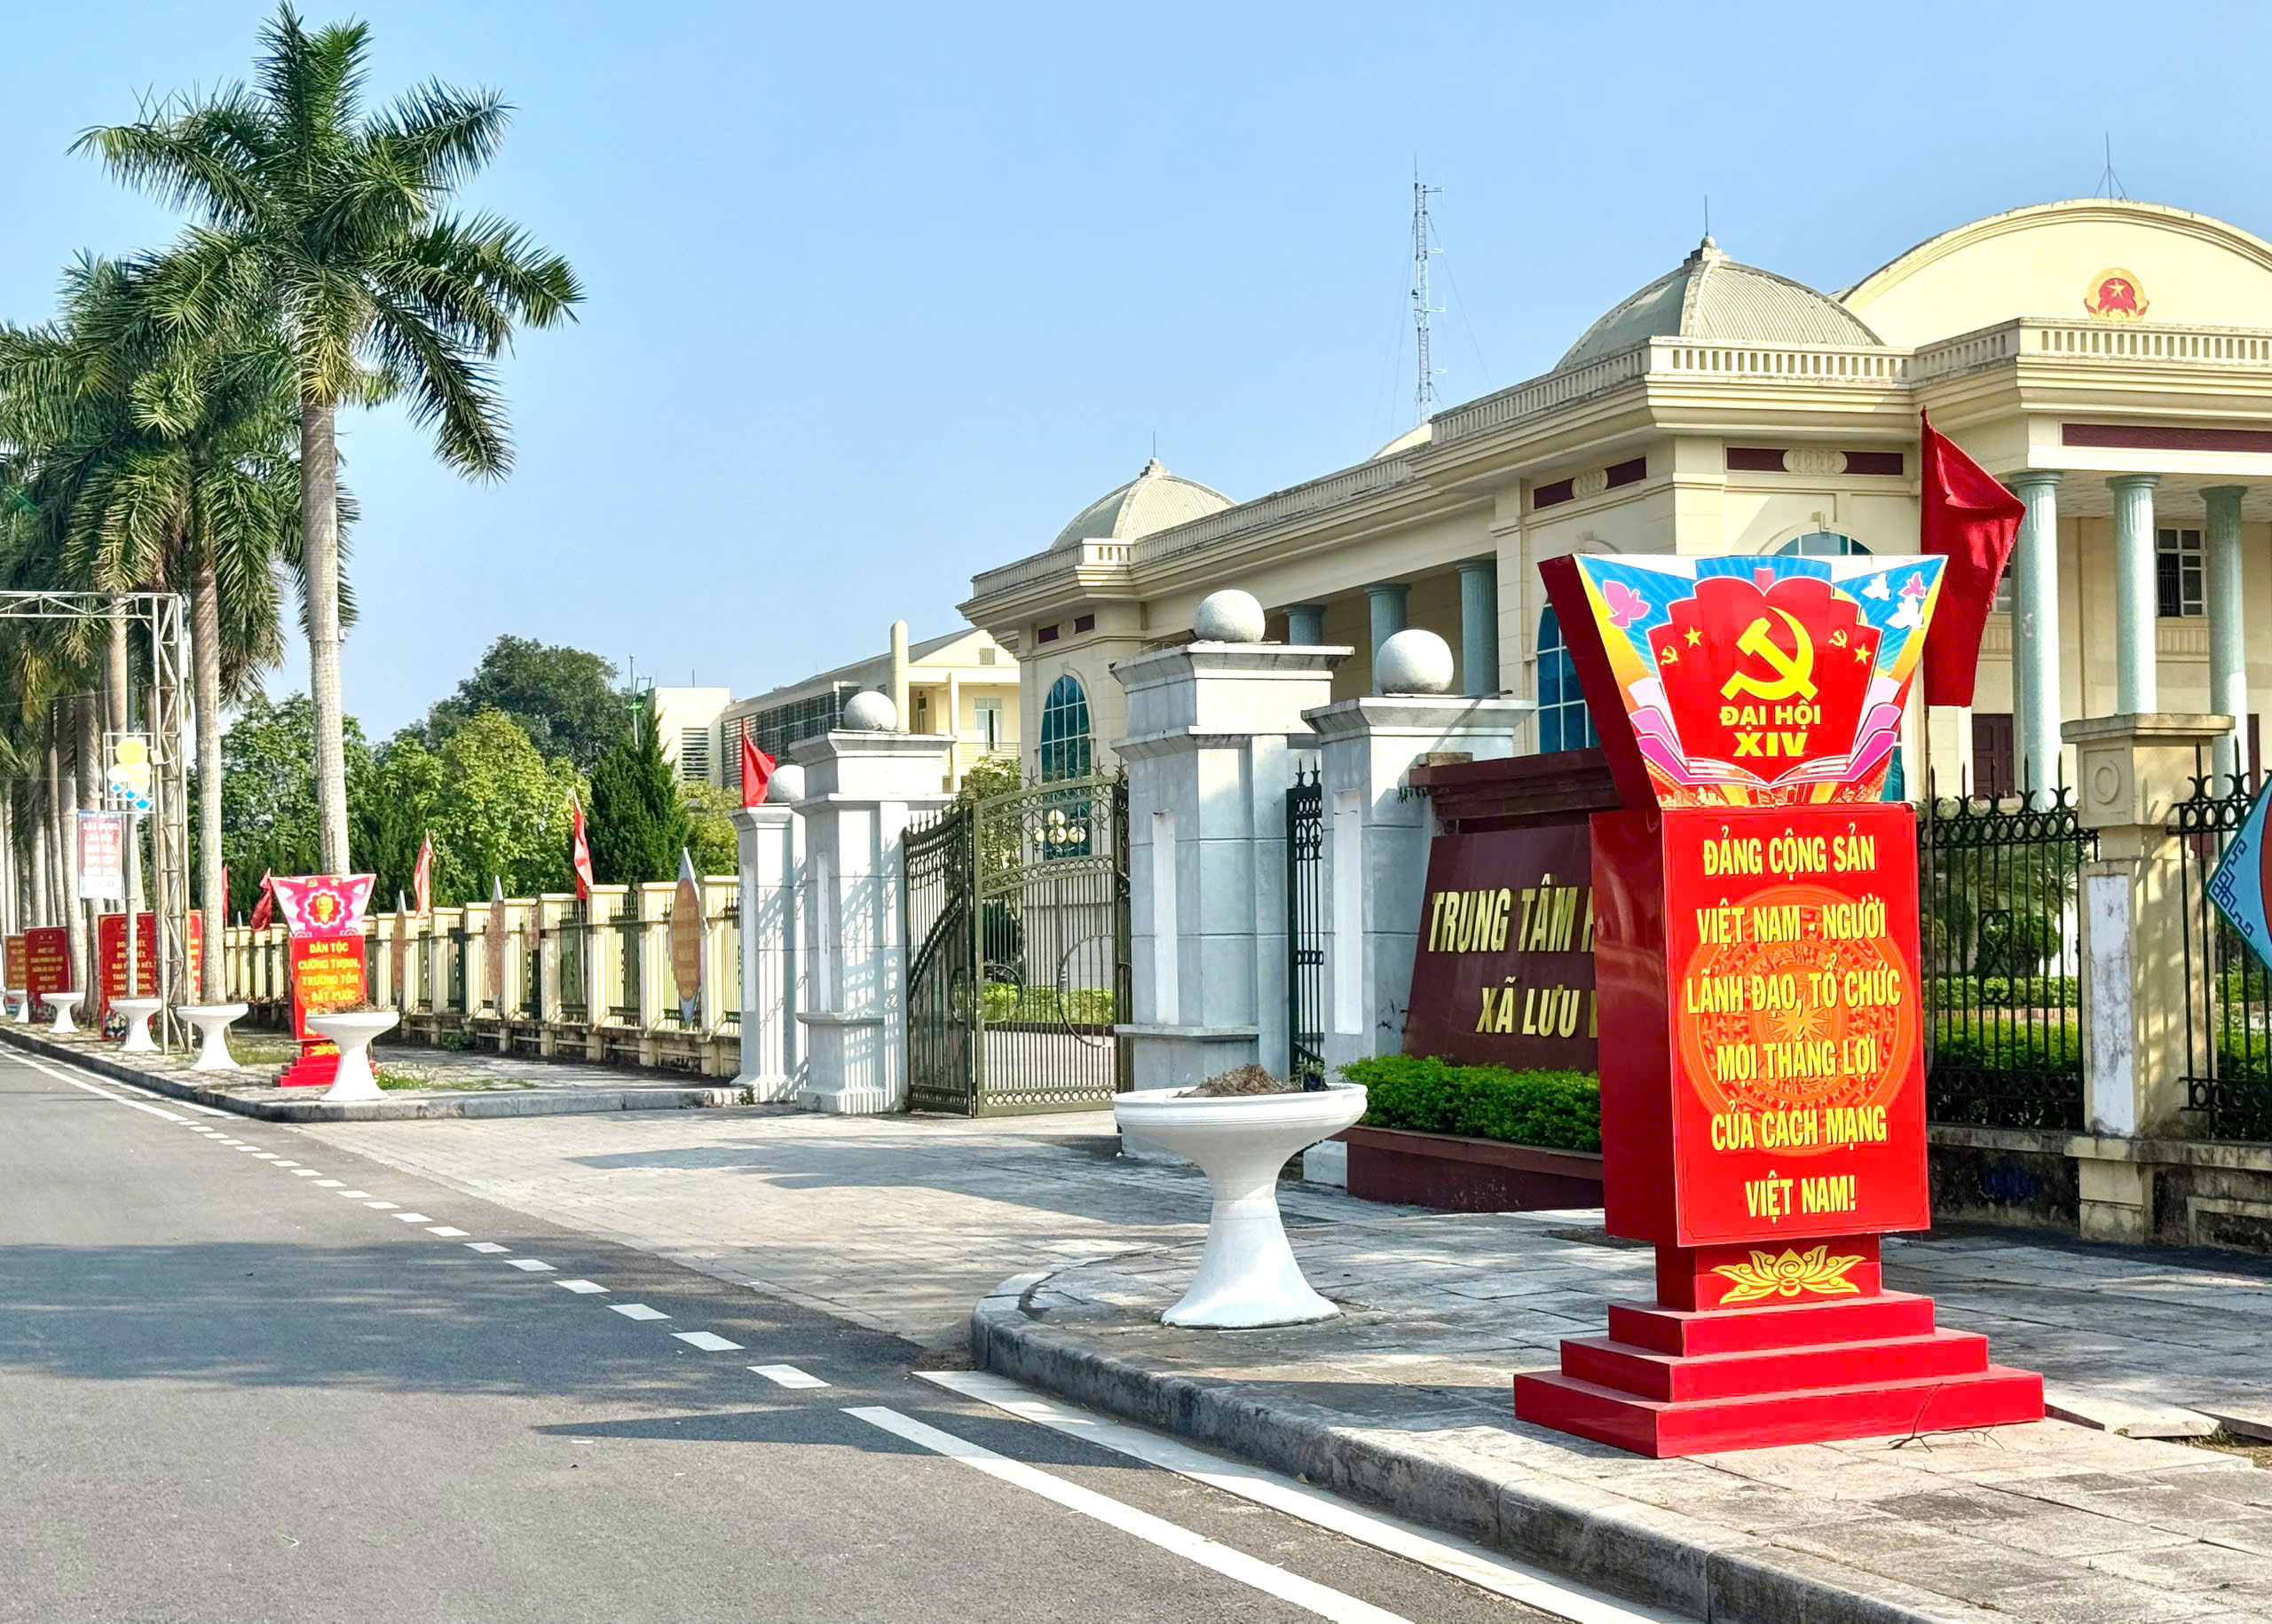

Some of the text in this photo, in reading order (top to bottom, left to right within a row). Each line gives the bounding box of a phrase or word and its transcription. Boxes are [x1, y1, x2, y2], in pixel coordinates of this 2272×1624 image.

[1720, 699, 1821, 733] ĐẠI HỘI
[1733, 732, 1807, 757] XIV
[1703, 822, 1875, 880] ĐẢNG CỘNG SẢN
[1428, 888, 1511, 953] TRUNG
[1518, 873, 1578, 952] TÂM
[1696, 898, 1746, 952] VIỆT
[1753, 905, 1802, 942] NAM
[1822, 893, 1887, 940] NGƯỜI
[329, 941, 349, 954] TỘC
[1475, 976, 1517, 1034] XÃ
[1522, 984, 1581, 1038] LƯU
[1686, 952, 1901, 1018] LÃNH ĐẠO, TỔ CHỨC
[1716, 1025, 1877, 1088] MỌI THẮNG LỢI
[1711, 1100, 1887, 1151] CỦA CÁCH MẠNG
[1745, 1170, 1856, 1223] VIỆT NAM!
